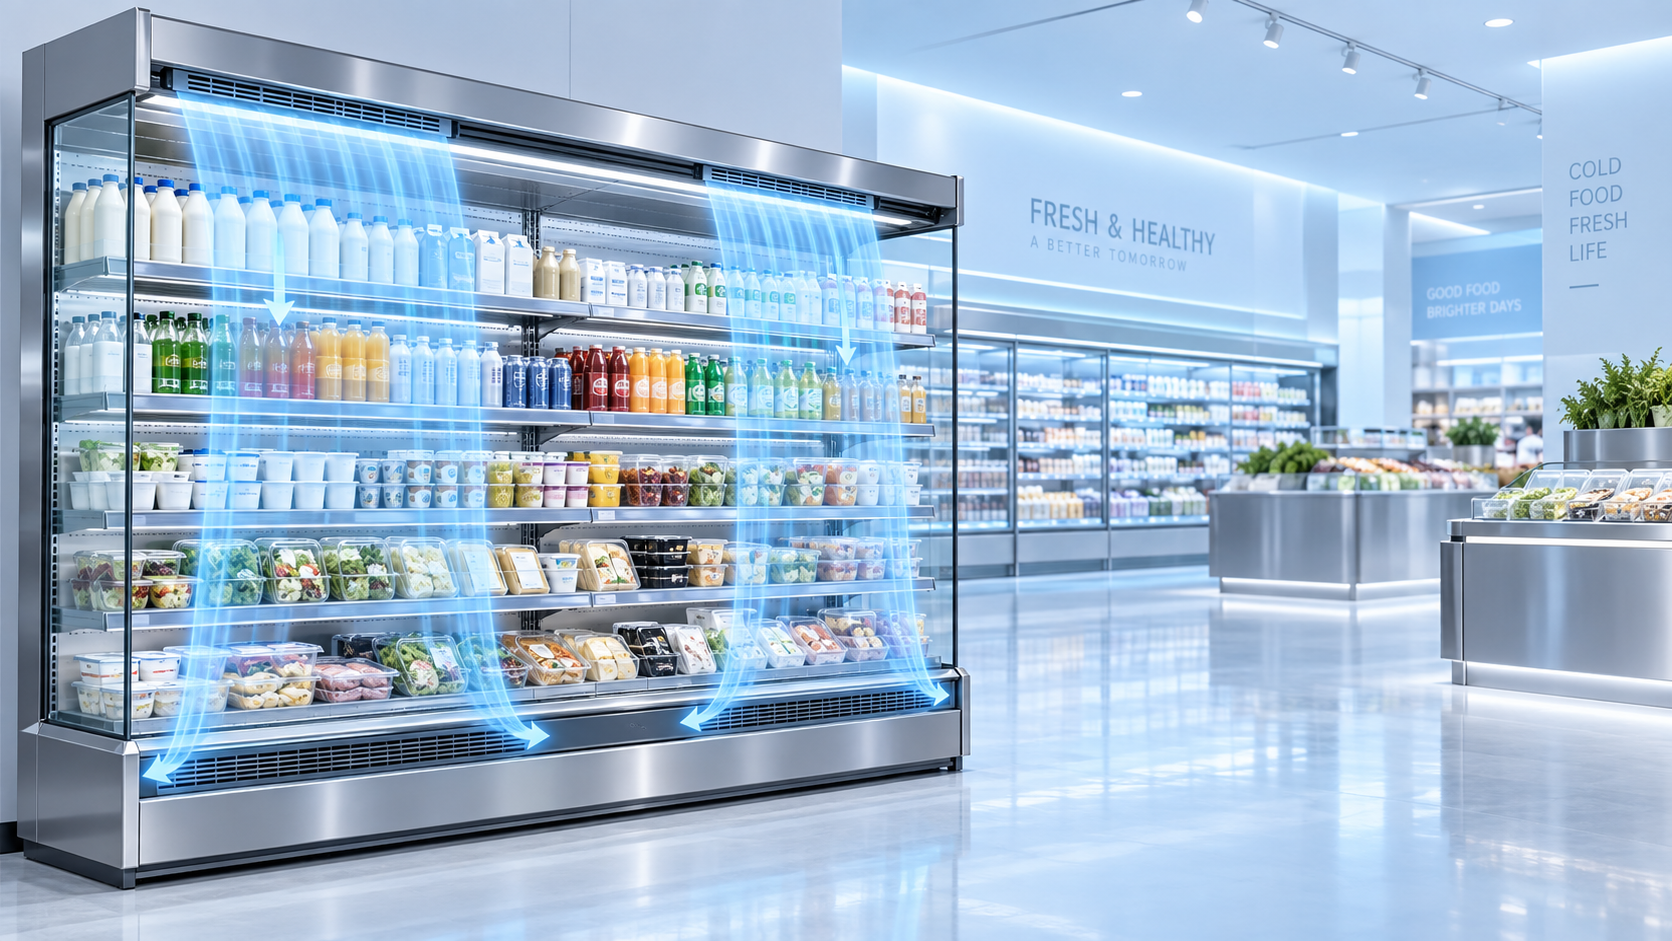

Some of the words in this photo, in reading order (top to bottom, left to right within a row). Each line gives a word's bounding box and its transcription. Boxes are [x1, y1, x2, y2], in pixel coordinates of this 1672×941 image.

[1569, 157, 1621, 180] COLD
[1569, 184, 1623, 208] FOOD
[1030, 197, 1098, 235] FRESH
[1107, 212, 1123, 240] &
[1132, 217, 1216, 255] HEALTHY
[1569, 211, 1628, 234] FRESH
[1030, 234, 1039, 249] A
[1047, 238, 1101, 259] BETTER
[1108, 247, 1187, 271] TOMORROW
[1569, 241, 1607, 262] LIFE
[1426, 284, 1463, 301] GOOD
[1465, 280, 1501, 296] FOOD
[1426, 301, 1487, 320] BRIGHTER
[1489, 298, 1522, 314] DAYS
